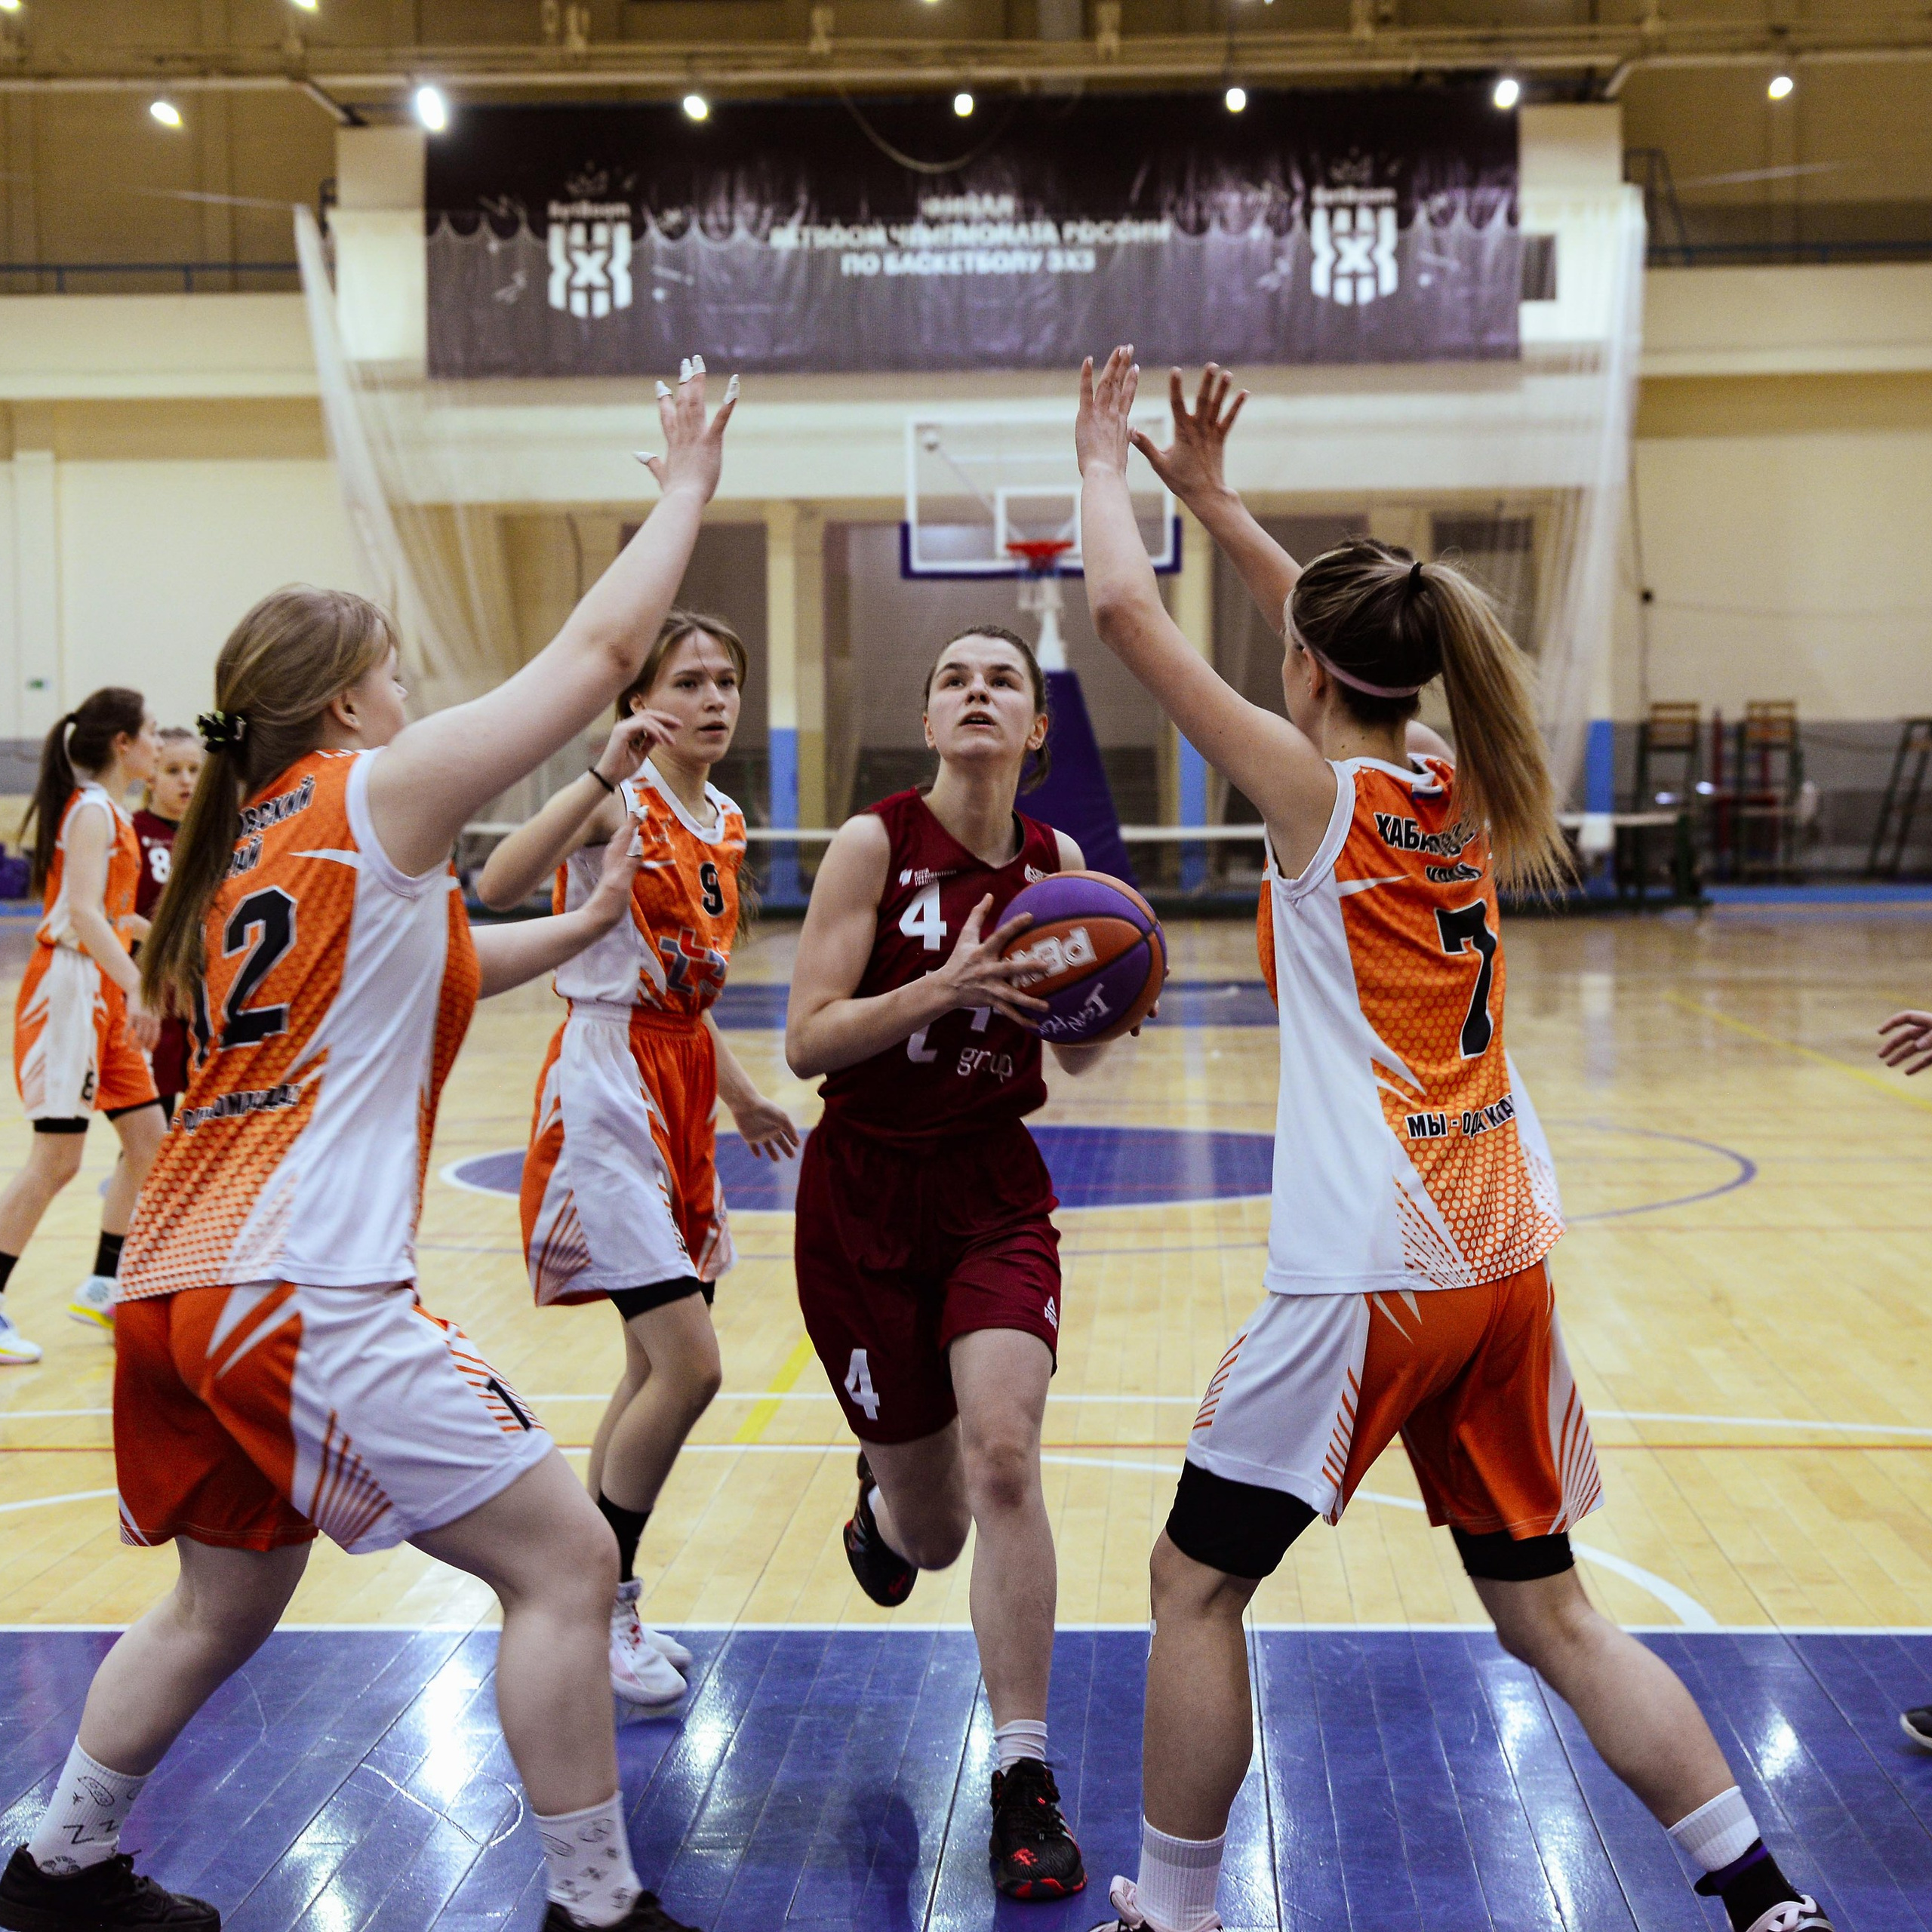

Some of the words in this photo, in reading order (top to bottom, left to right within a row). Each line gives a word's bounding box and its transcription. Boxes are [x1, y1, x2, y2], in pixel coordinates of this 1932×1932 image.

[1060, 219, 1170, 245] РОССИИ
[841, 252, 881, 276] ПО
[883, 250, 1044, 275] БАСКЕТБОЛУ
[148, 847, 171, 884] 8
[699, 861, 727, 918] 9
[898, 879, 947, 951] 4
[1435, 898, 1497, 1060] 7
[1404, 1112, 1448, 1140] МЫ
[844, 1349, 881, 1420] 4
